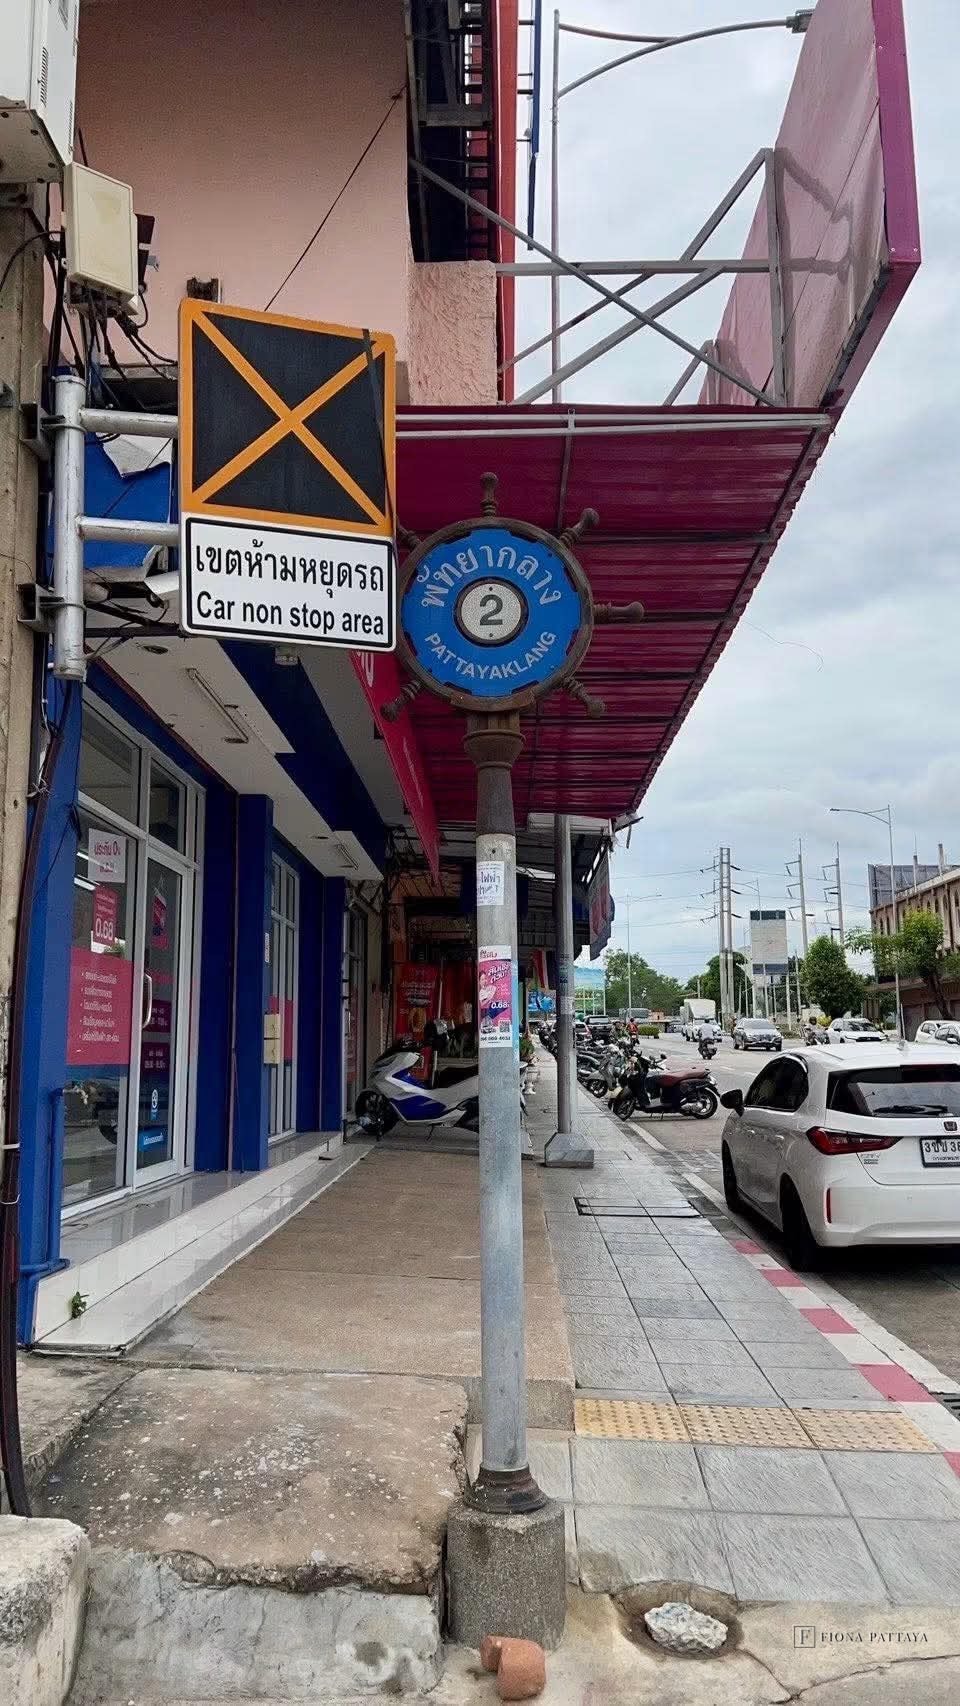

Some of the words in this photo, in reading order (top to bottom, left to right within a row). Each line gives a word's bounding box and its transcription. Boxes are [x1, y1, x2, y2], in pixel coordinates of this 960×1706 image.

[196, 538, 384, 598] เขตห้ามหยุดรถ
[416, 545, 562, 607] พัทยากลาง
[197, 590, 235, 621] Car
[243, 601, 282, 625] non
[289, 602, 335, 634] stop
[342, 611, 384, 635] area
[479, 594, 503, 626] 2
[424, 631, 557, 680] PATTAYAKLANG
